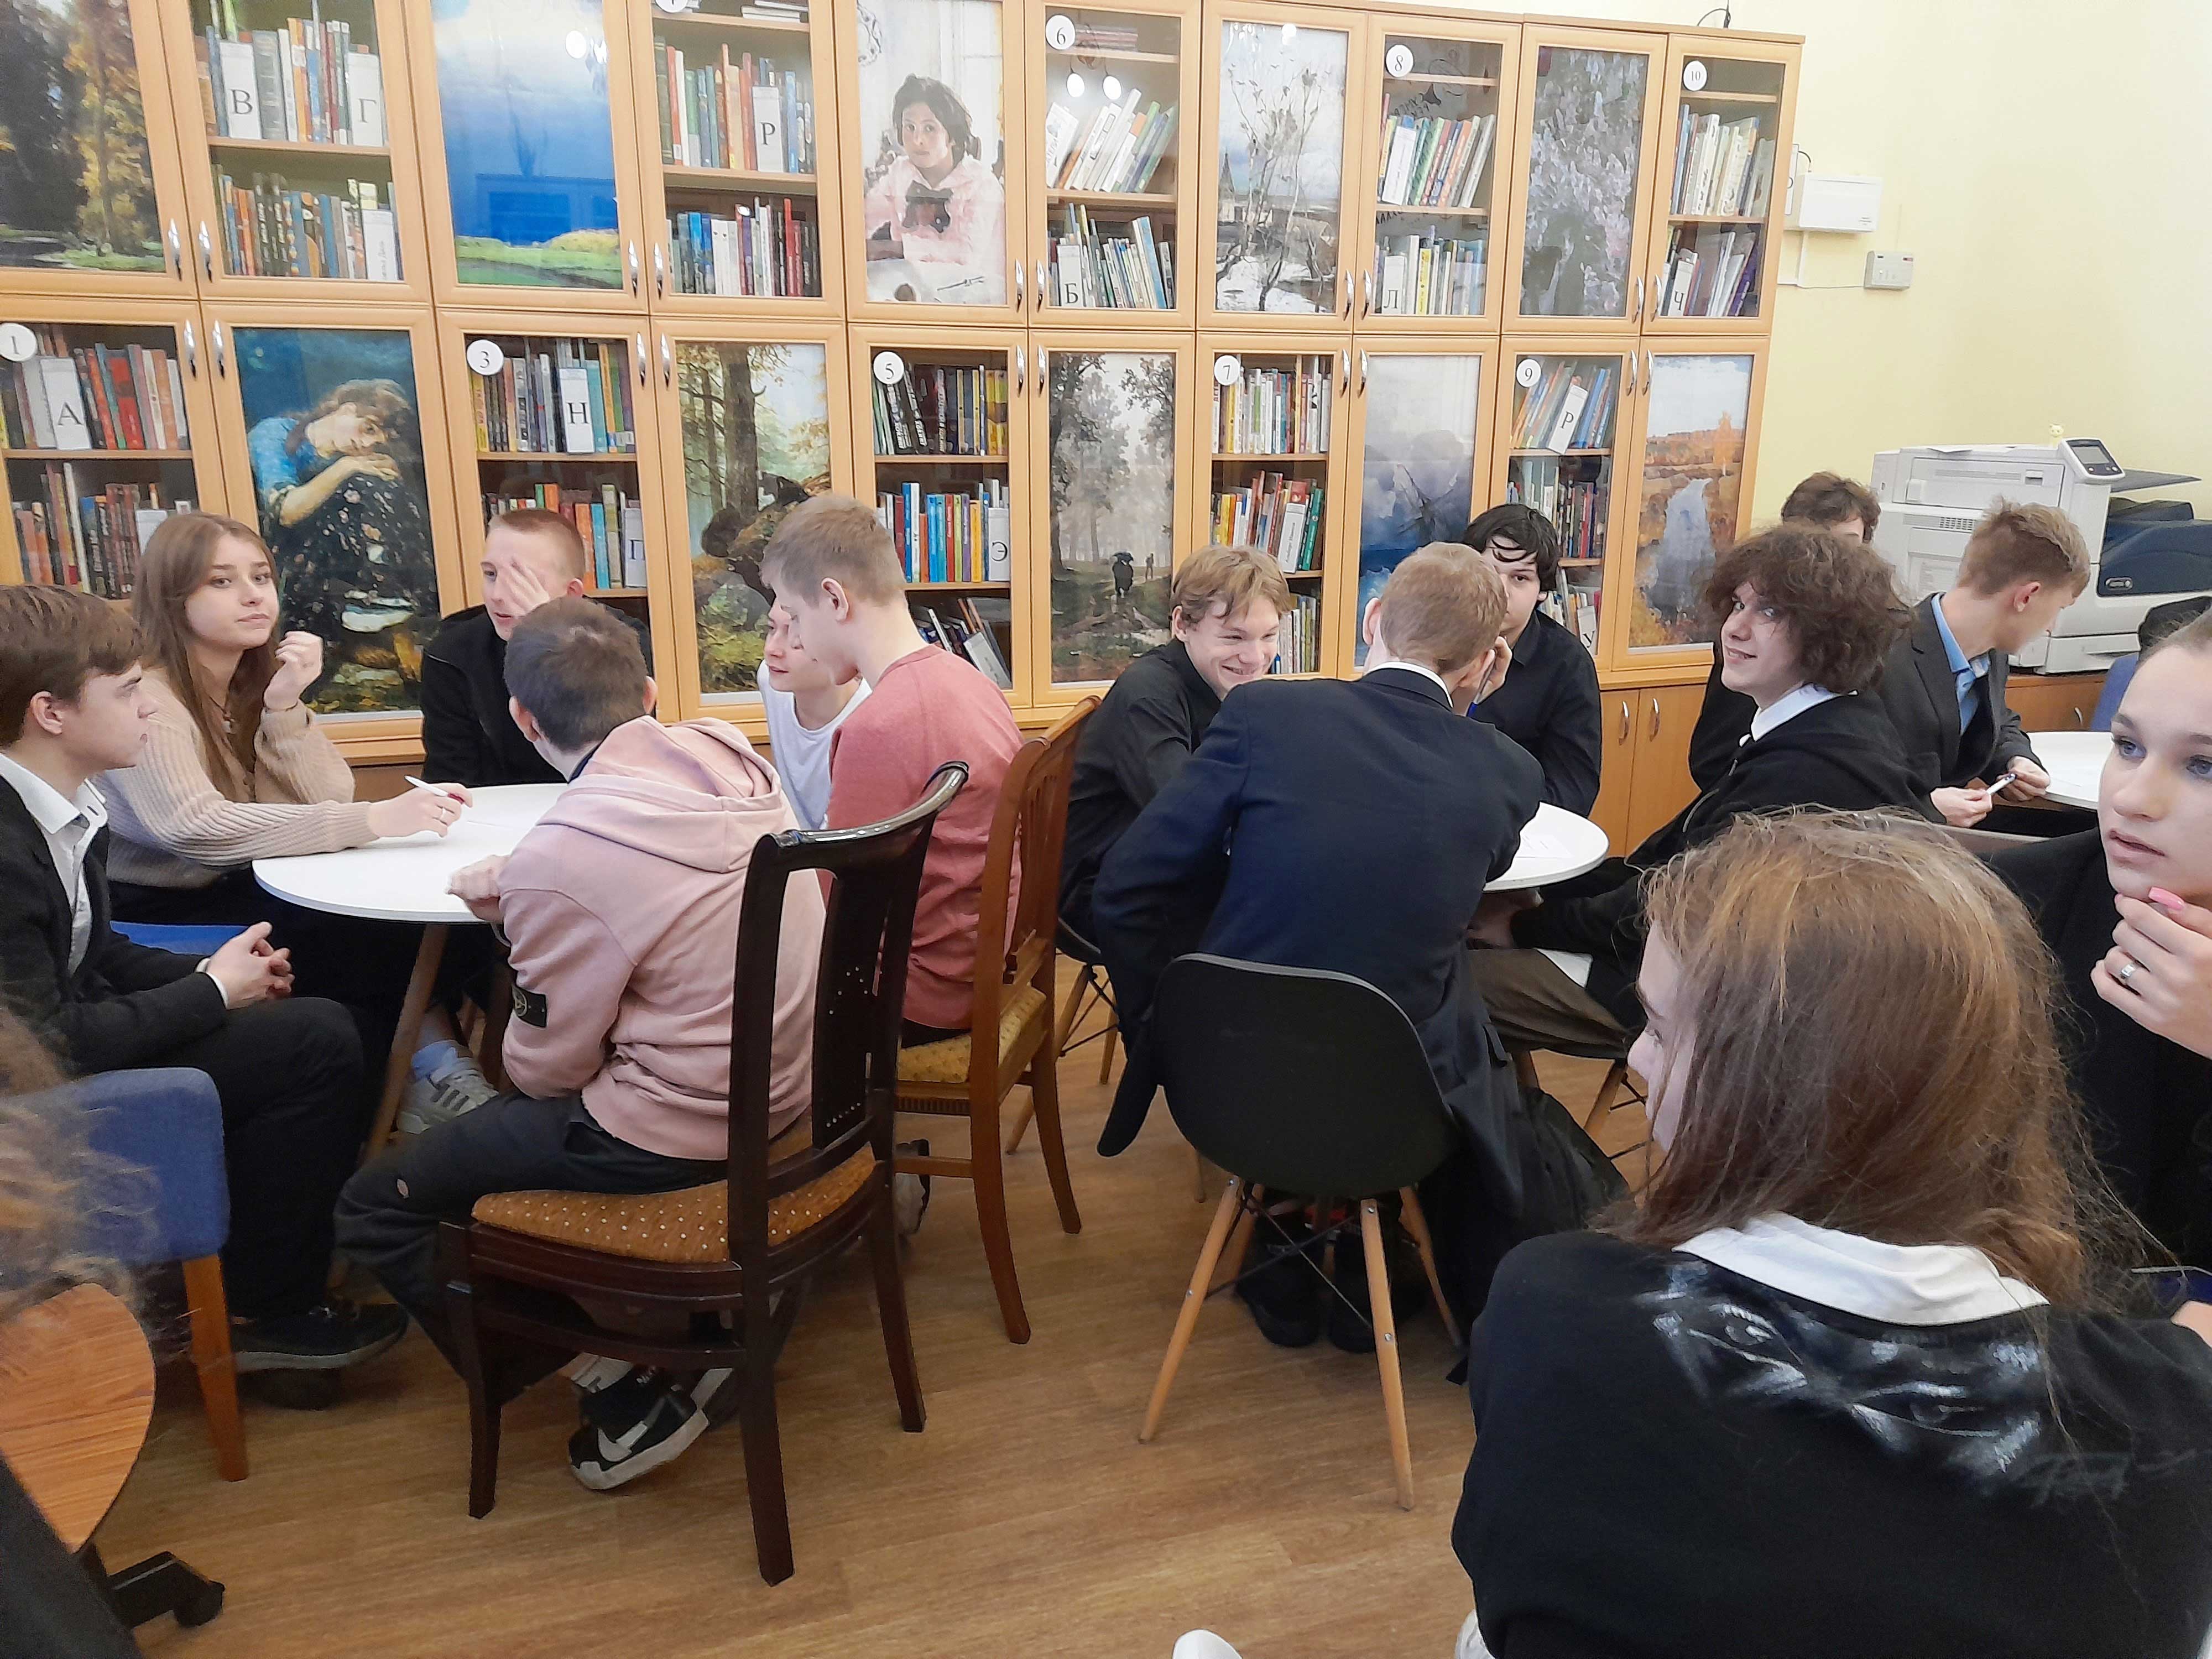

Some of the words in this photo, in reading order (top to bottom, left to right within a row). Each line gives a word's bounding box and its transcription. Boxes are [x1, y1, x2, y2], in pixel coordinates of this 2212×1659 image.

[1056, 28, 1066, 45] 6
[1395, 55, 1404, 71] 8
[1691, 71, 1701, 81] 10
[231, 89, 252, 114] В
[359, 98, 377, 123] Г
[761, 122, 775, 145] Р
[1065, 283, 1078, 304] Б
[1384, 290, 1398, 309] Л
[1674, 291, 1684, 311] Ч
[12, 336, 19, 354] 1
[479, 351, 490, 368] 3
[886, 363, 894, 379] 5
[1223, 365, 1230, 380] 7
[1525, 368, 1533, 381] 9
[58, 402, 83, 426] А
[567, 403, 590, 424] Н
[1562, 411, 1573, 429] Р
[992, 541, 1008, 562] Э
